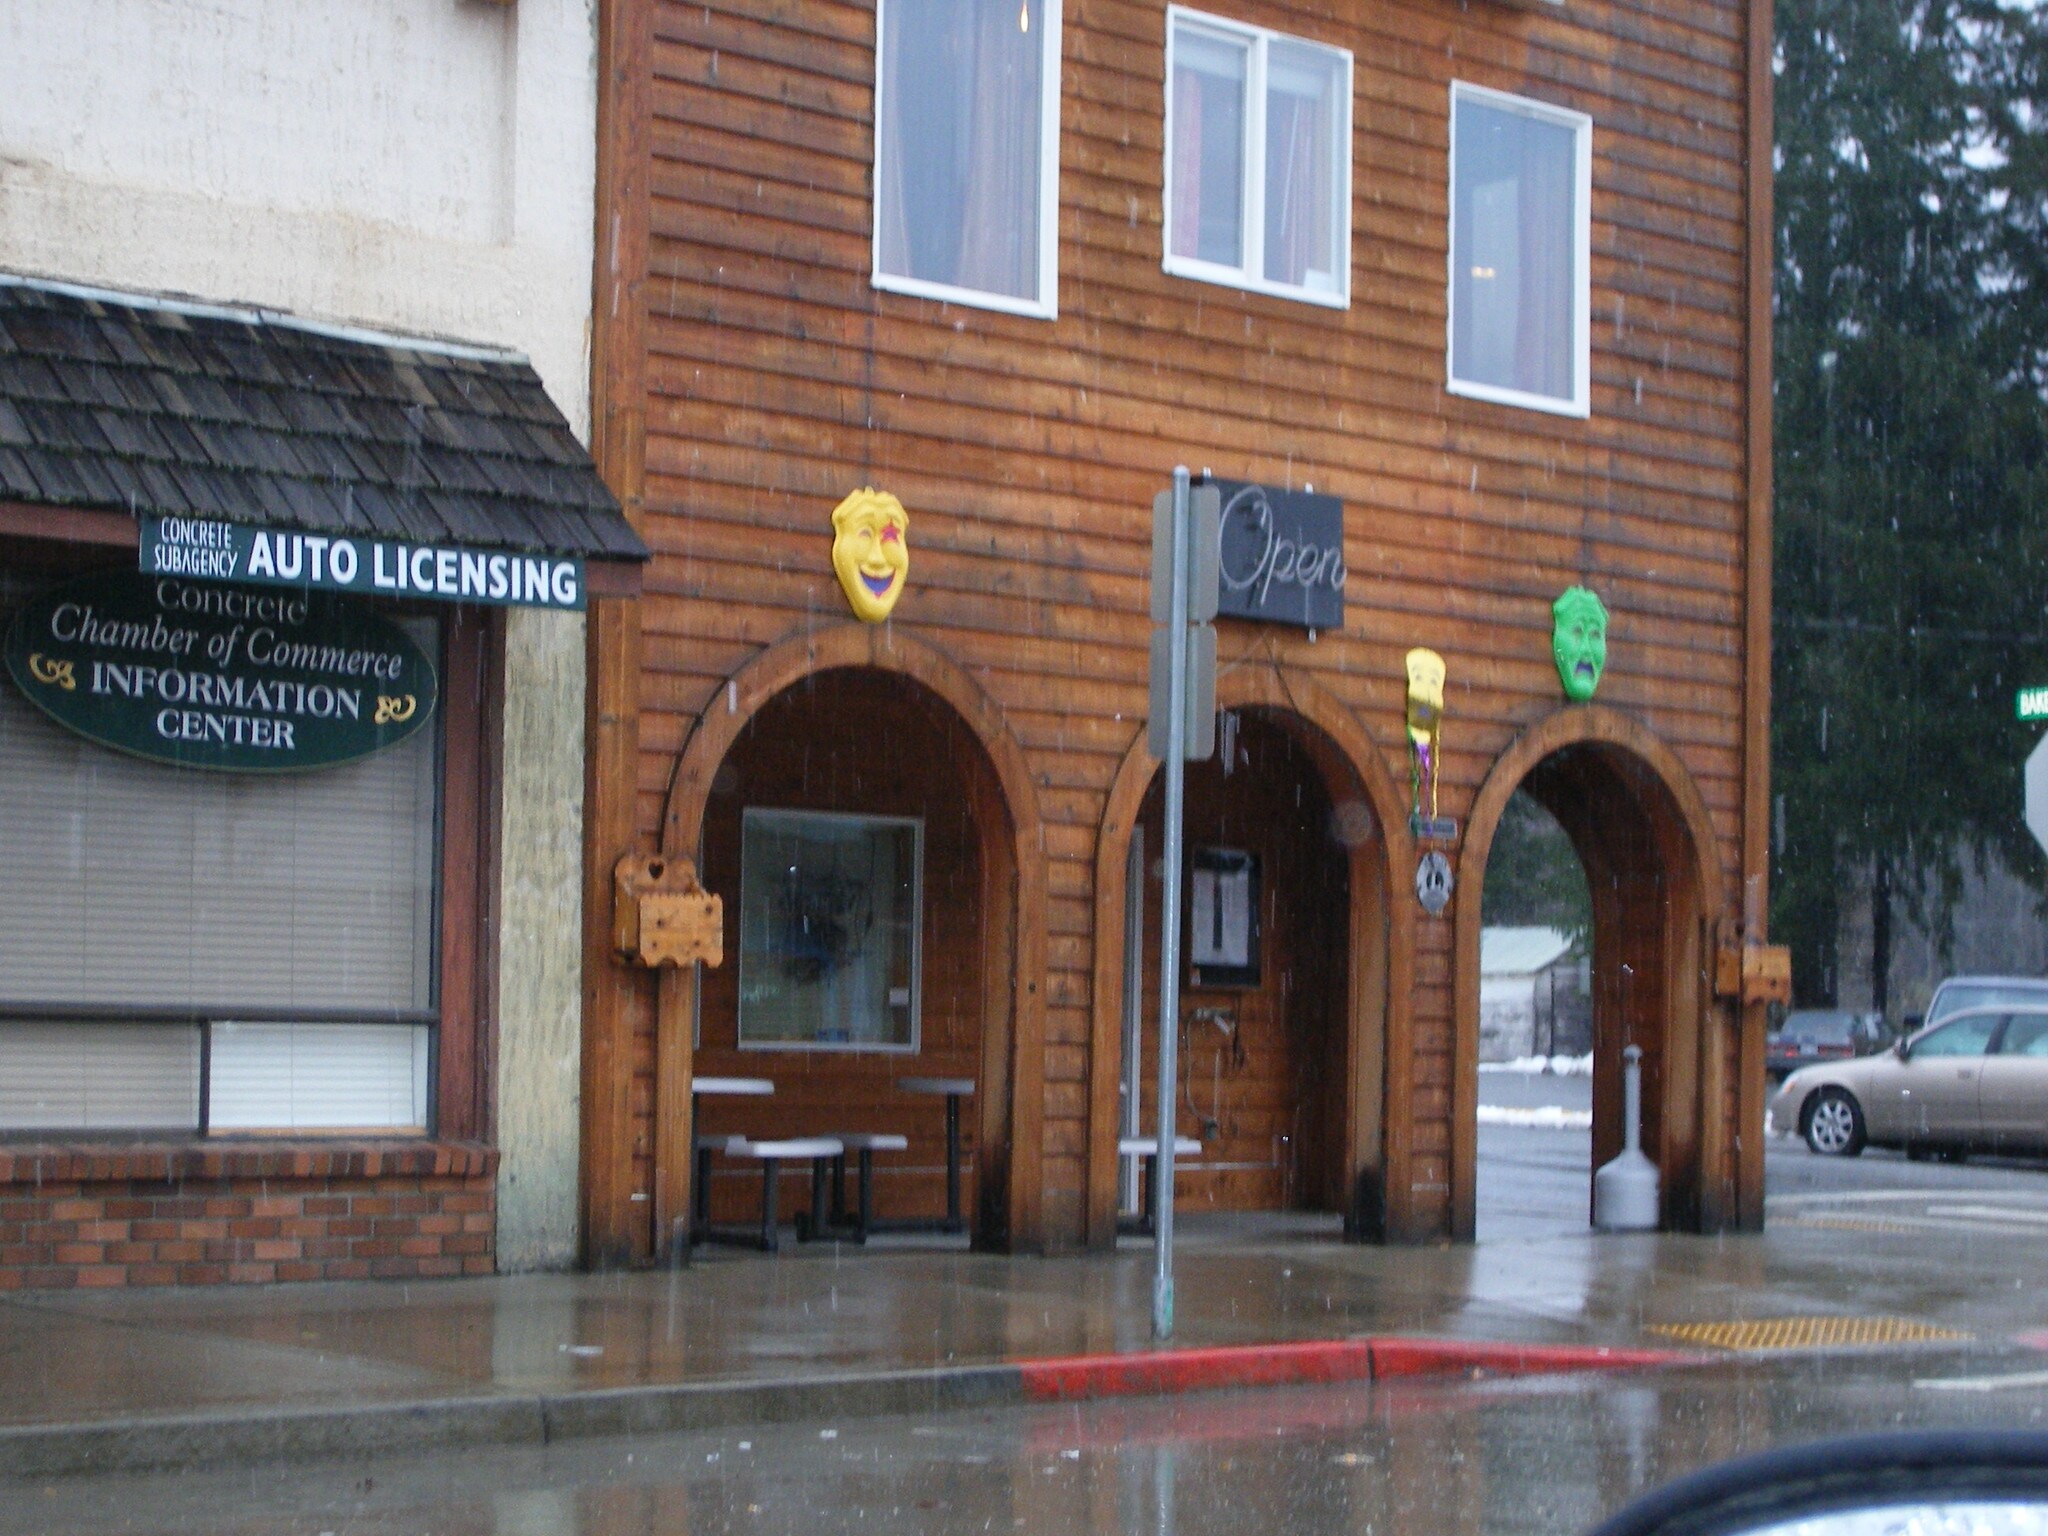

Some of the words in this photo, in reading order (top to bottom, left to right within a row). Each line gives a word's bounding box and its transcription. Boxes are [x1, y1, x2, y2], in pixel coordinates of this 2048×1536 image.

[161, 516, 232, 549] CONCRETE
[1219, 484, 1347, 607] Open
[154, 543, 238, 578] SUBAGENCY
[248, 531, 358, 585] AUTO
[373, 543, 576, 605] LICENSING
[157, 578, 307, 626] Concrete
[51, 602, 199, 655] Chamber
[207, 623, 244, 668] of
[247, 627, 402, 681] Commerce
[92, 660, 361, 720] INFORMATION
[156, 708, 295, 750] CENTER
